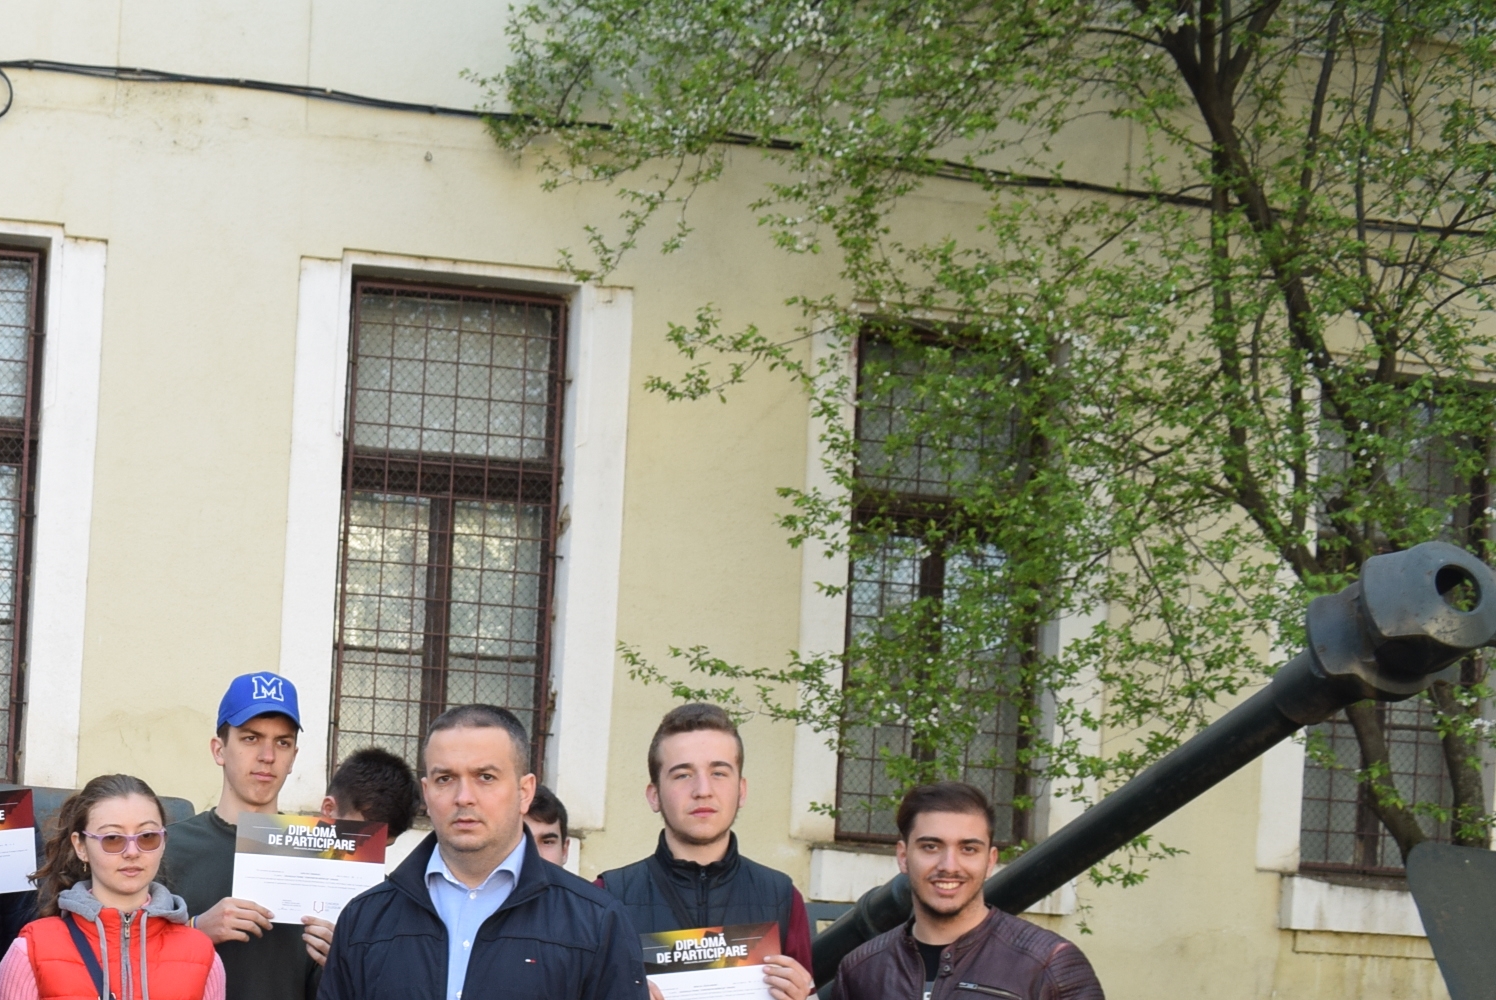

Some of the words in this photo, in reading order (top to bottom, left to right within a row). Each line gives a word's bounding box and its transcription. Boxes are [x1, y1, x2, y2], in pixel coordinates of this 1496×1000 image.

[252, 676, 284, 702] M
[288, 824, 337, 838] DIPLOMĂ
[268, 834, 282, 845] DE
[285, 836, 356, 851] PARTICIPARE
[675, 933, 727, 951] DIPLOMĂ
[656, 952, 672, 964] DE
[673, 945, 748, 962] PARTICIPARE
